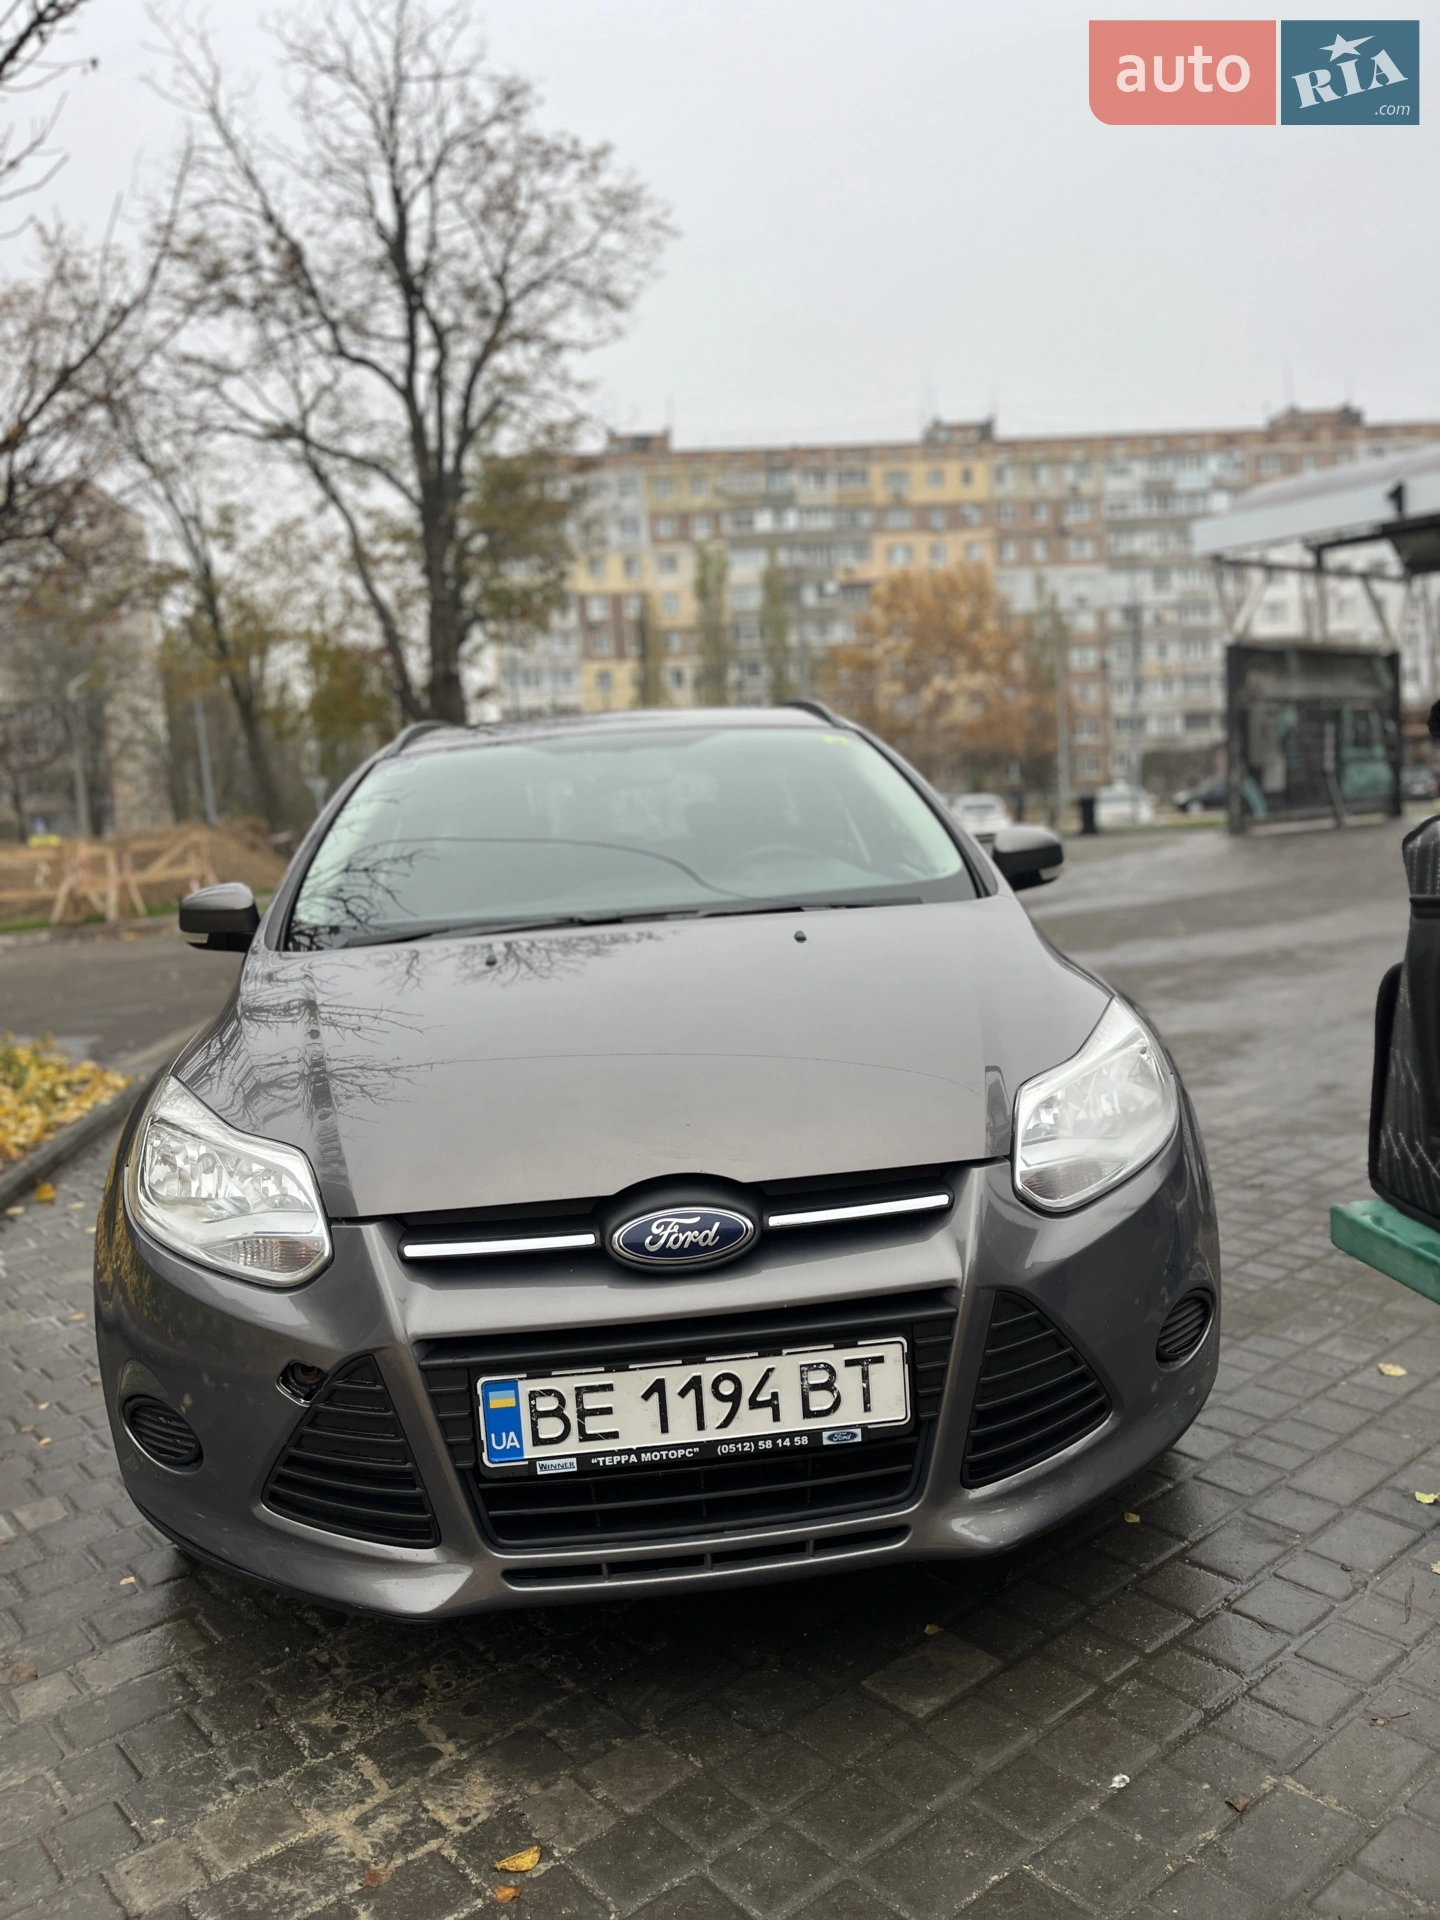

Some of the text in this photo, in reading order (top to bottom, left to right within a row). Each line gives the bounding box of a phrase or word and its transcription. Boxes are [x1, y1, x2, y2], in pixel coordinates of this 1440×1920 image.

[644, 1216, 720, 1252] Ford
[528, 1355, 885, 1447] BE 1194 BT
[491, 1431, 520, 1450] UA
[717, 1436, 809, 1456] (0512) 58 14 58
